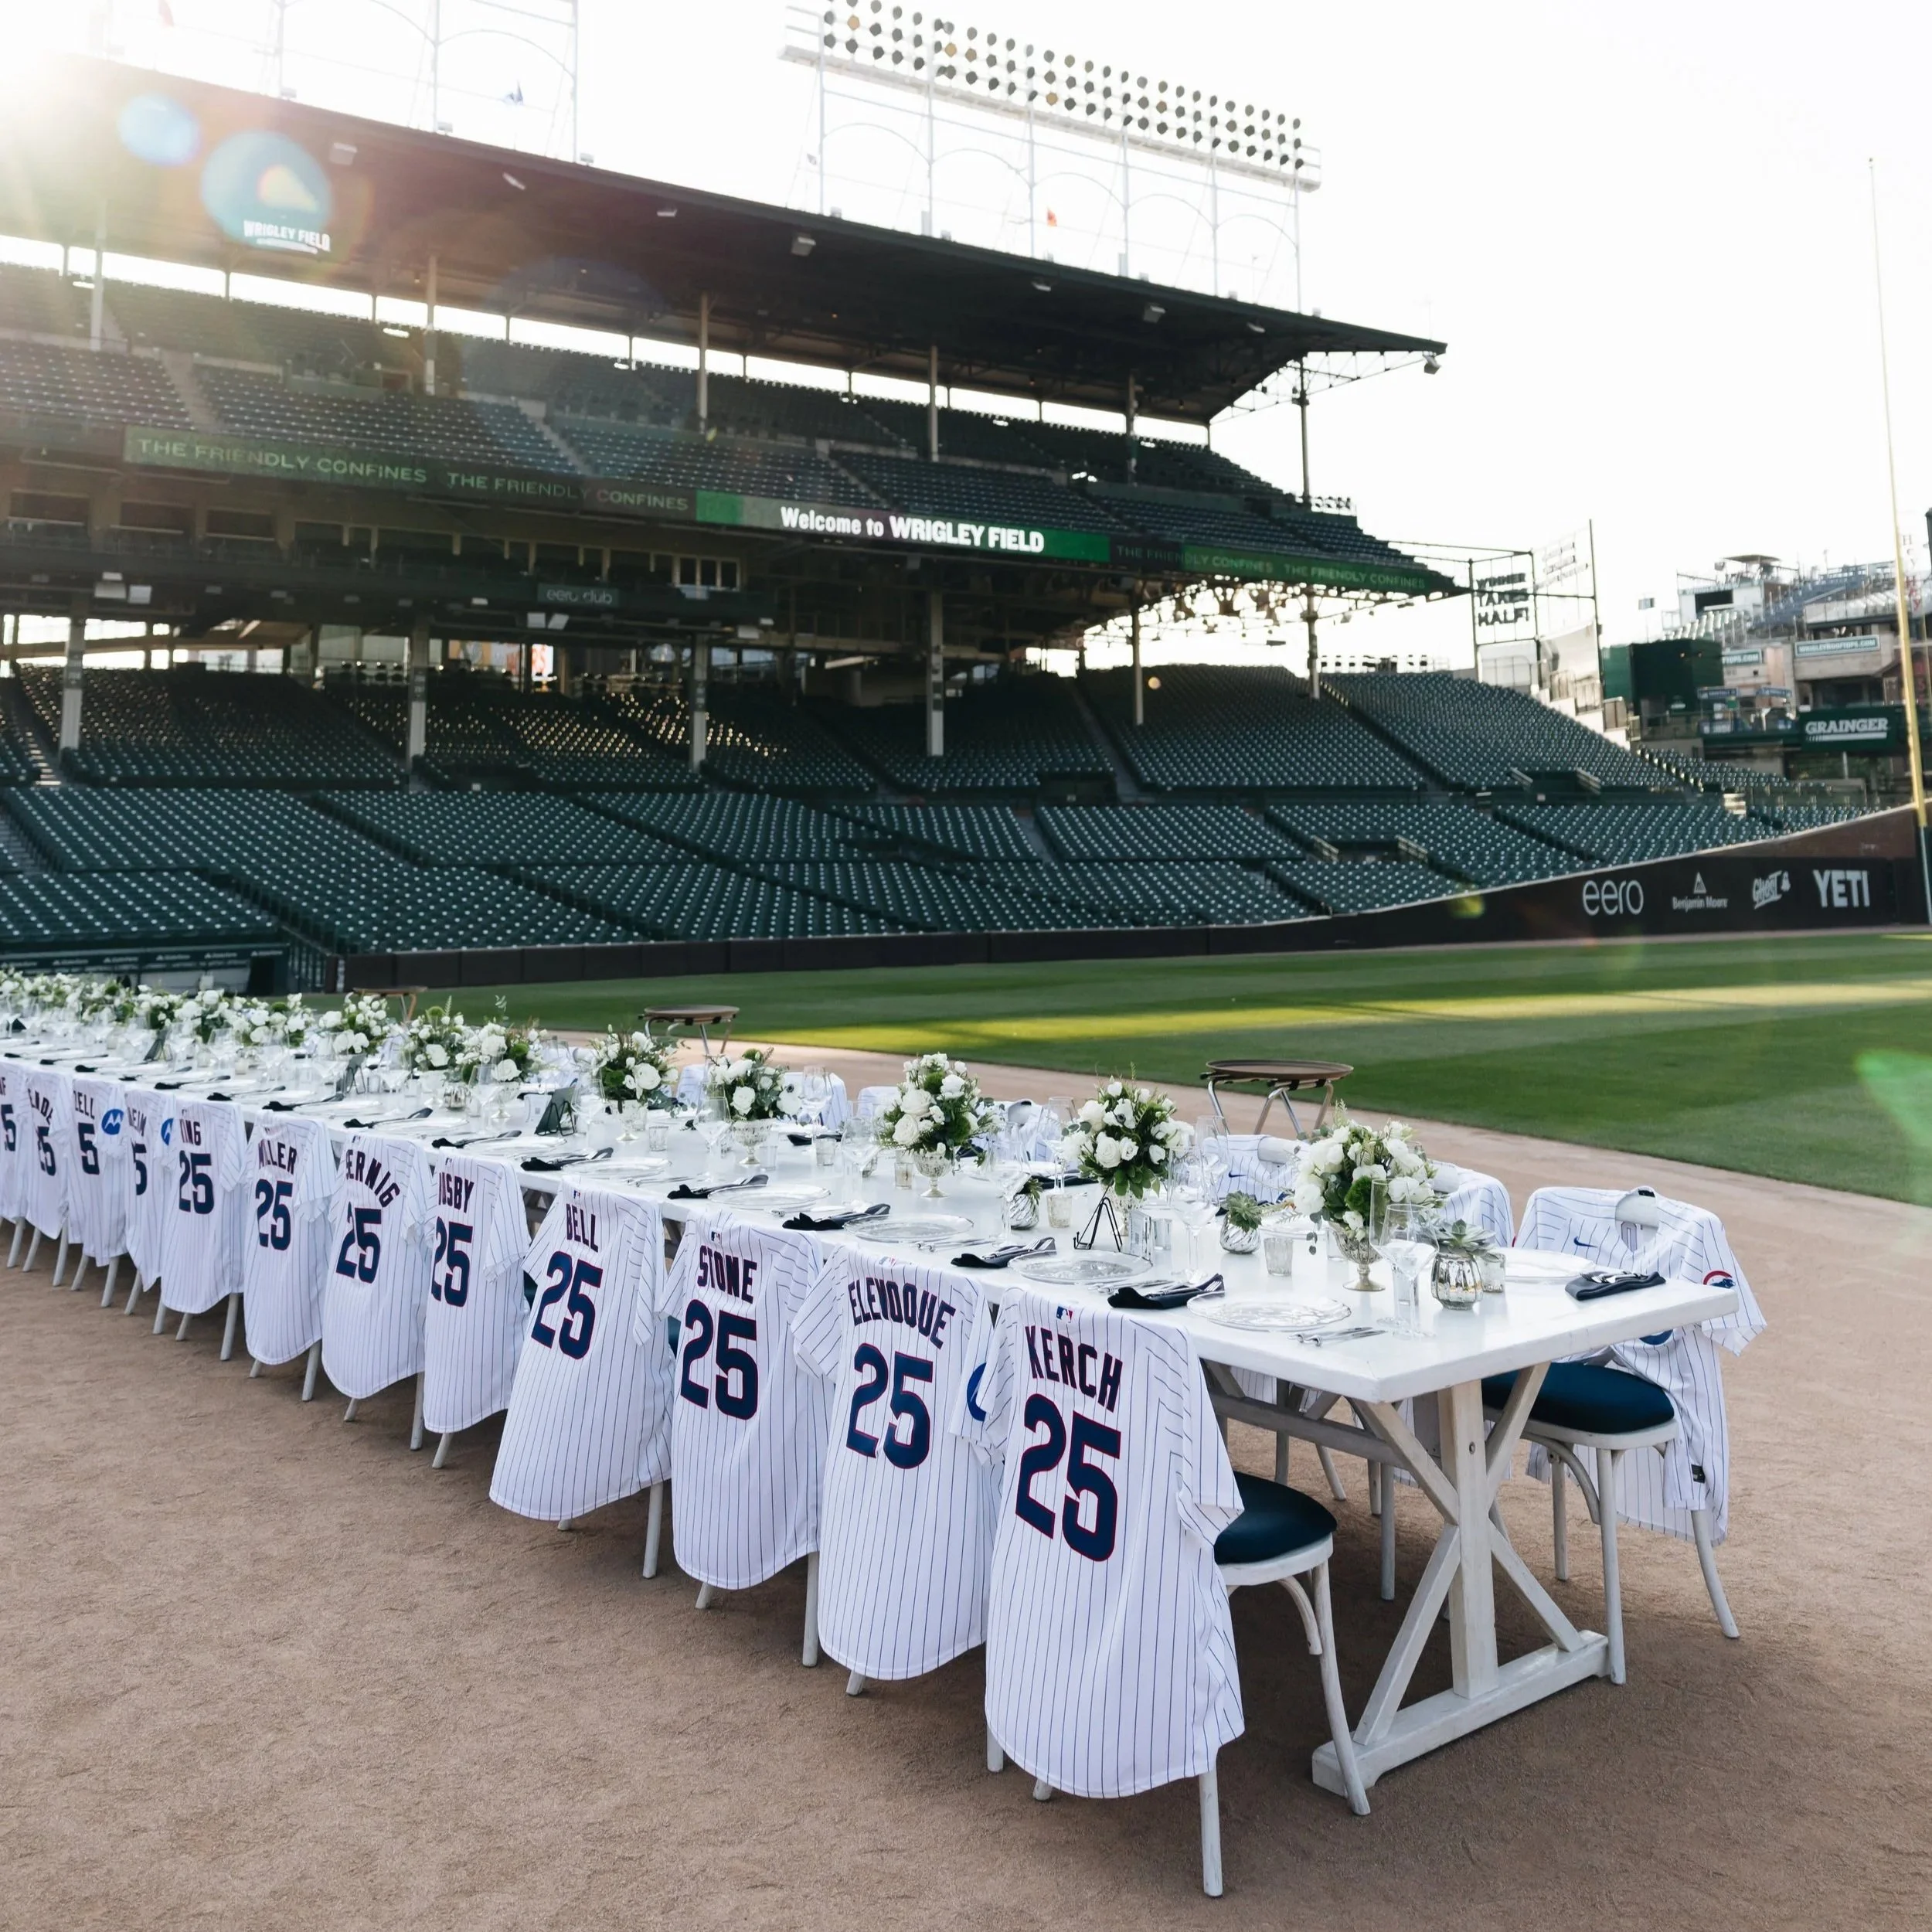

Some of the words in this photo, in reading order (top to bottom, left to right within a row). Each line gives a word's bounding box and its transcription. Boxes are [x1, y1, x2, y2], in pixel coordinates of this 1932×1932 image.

[243, 220, 296, 240] WRIGLEY
[138, 438, 186, 457] THE
[195, 444, 309, 470] FRIENDLY
[317, 457, 427, 483] CONFINES
[447, 471, 487, 490] THE
[494, 477, 588, 500] FRIENDLY
[596, 488, 689, 511] CONFINES
[780, 506, 862, 536] Welcome
[866, 517, 885, 536] to
[889, 515, 985, 546] WRIGLEY
[988, 526, 1045, 553] FIELD
[1805, 717, 1888, 735] GRAINGER
[1582, 879, 1644, 916] eero
[1672, 896, 1705, 913] Benjamin
[1706, 896, 1729, 909] Moore
[1812, 869, 1870, 908] YETI
[179, 1150, 215, 1215] 25
[255, 1179, 294, 1251] 25
[335, 1201, 382, 1284] 25
[566, 1203, 599, 1253] BELL
[431, 1216, 474, 1308] 25
[697, 1245, 757, 1304] STONE
[531, 1250, 604, 1360] 25
[680, 1298, 759, 1420] 25
[1025, 1325, 1123, 1413] KERCH
[846, 1342, 934, 1469] 25
[1015, 1393, 1122, 1563] 25
